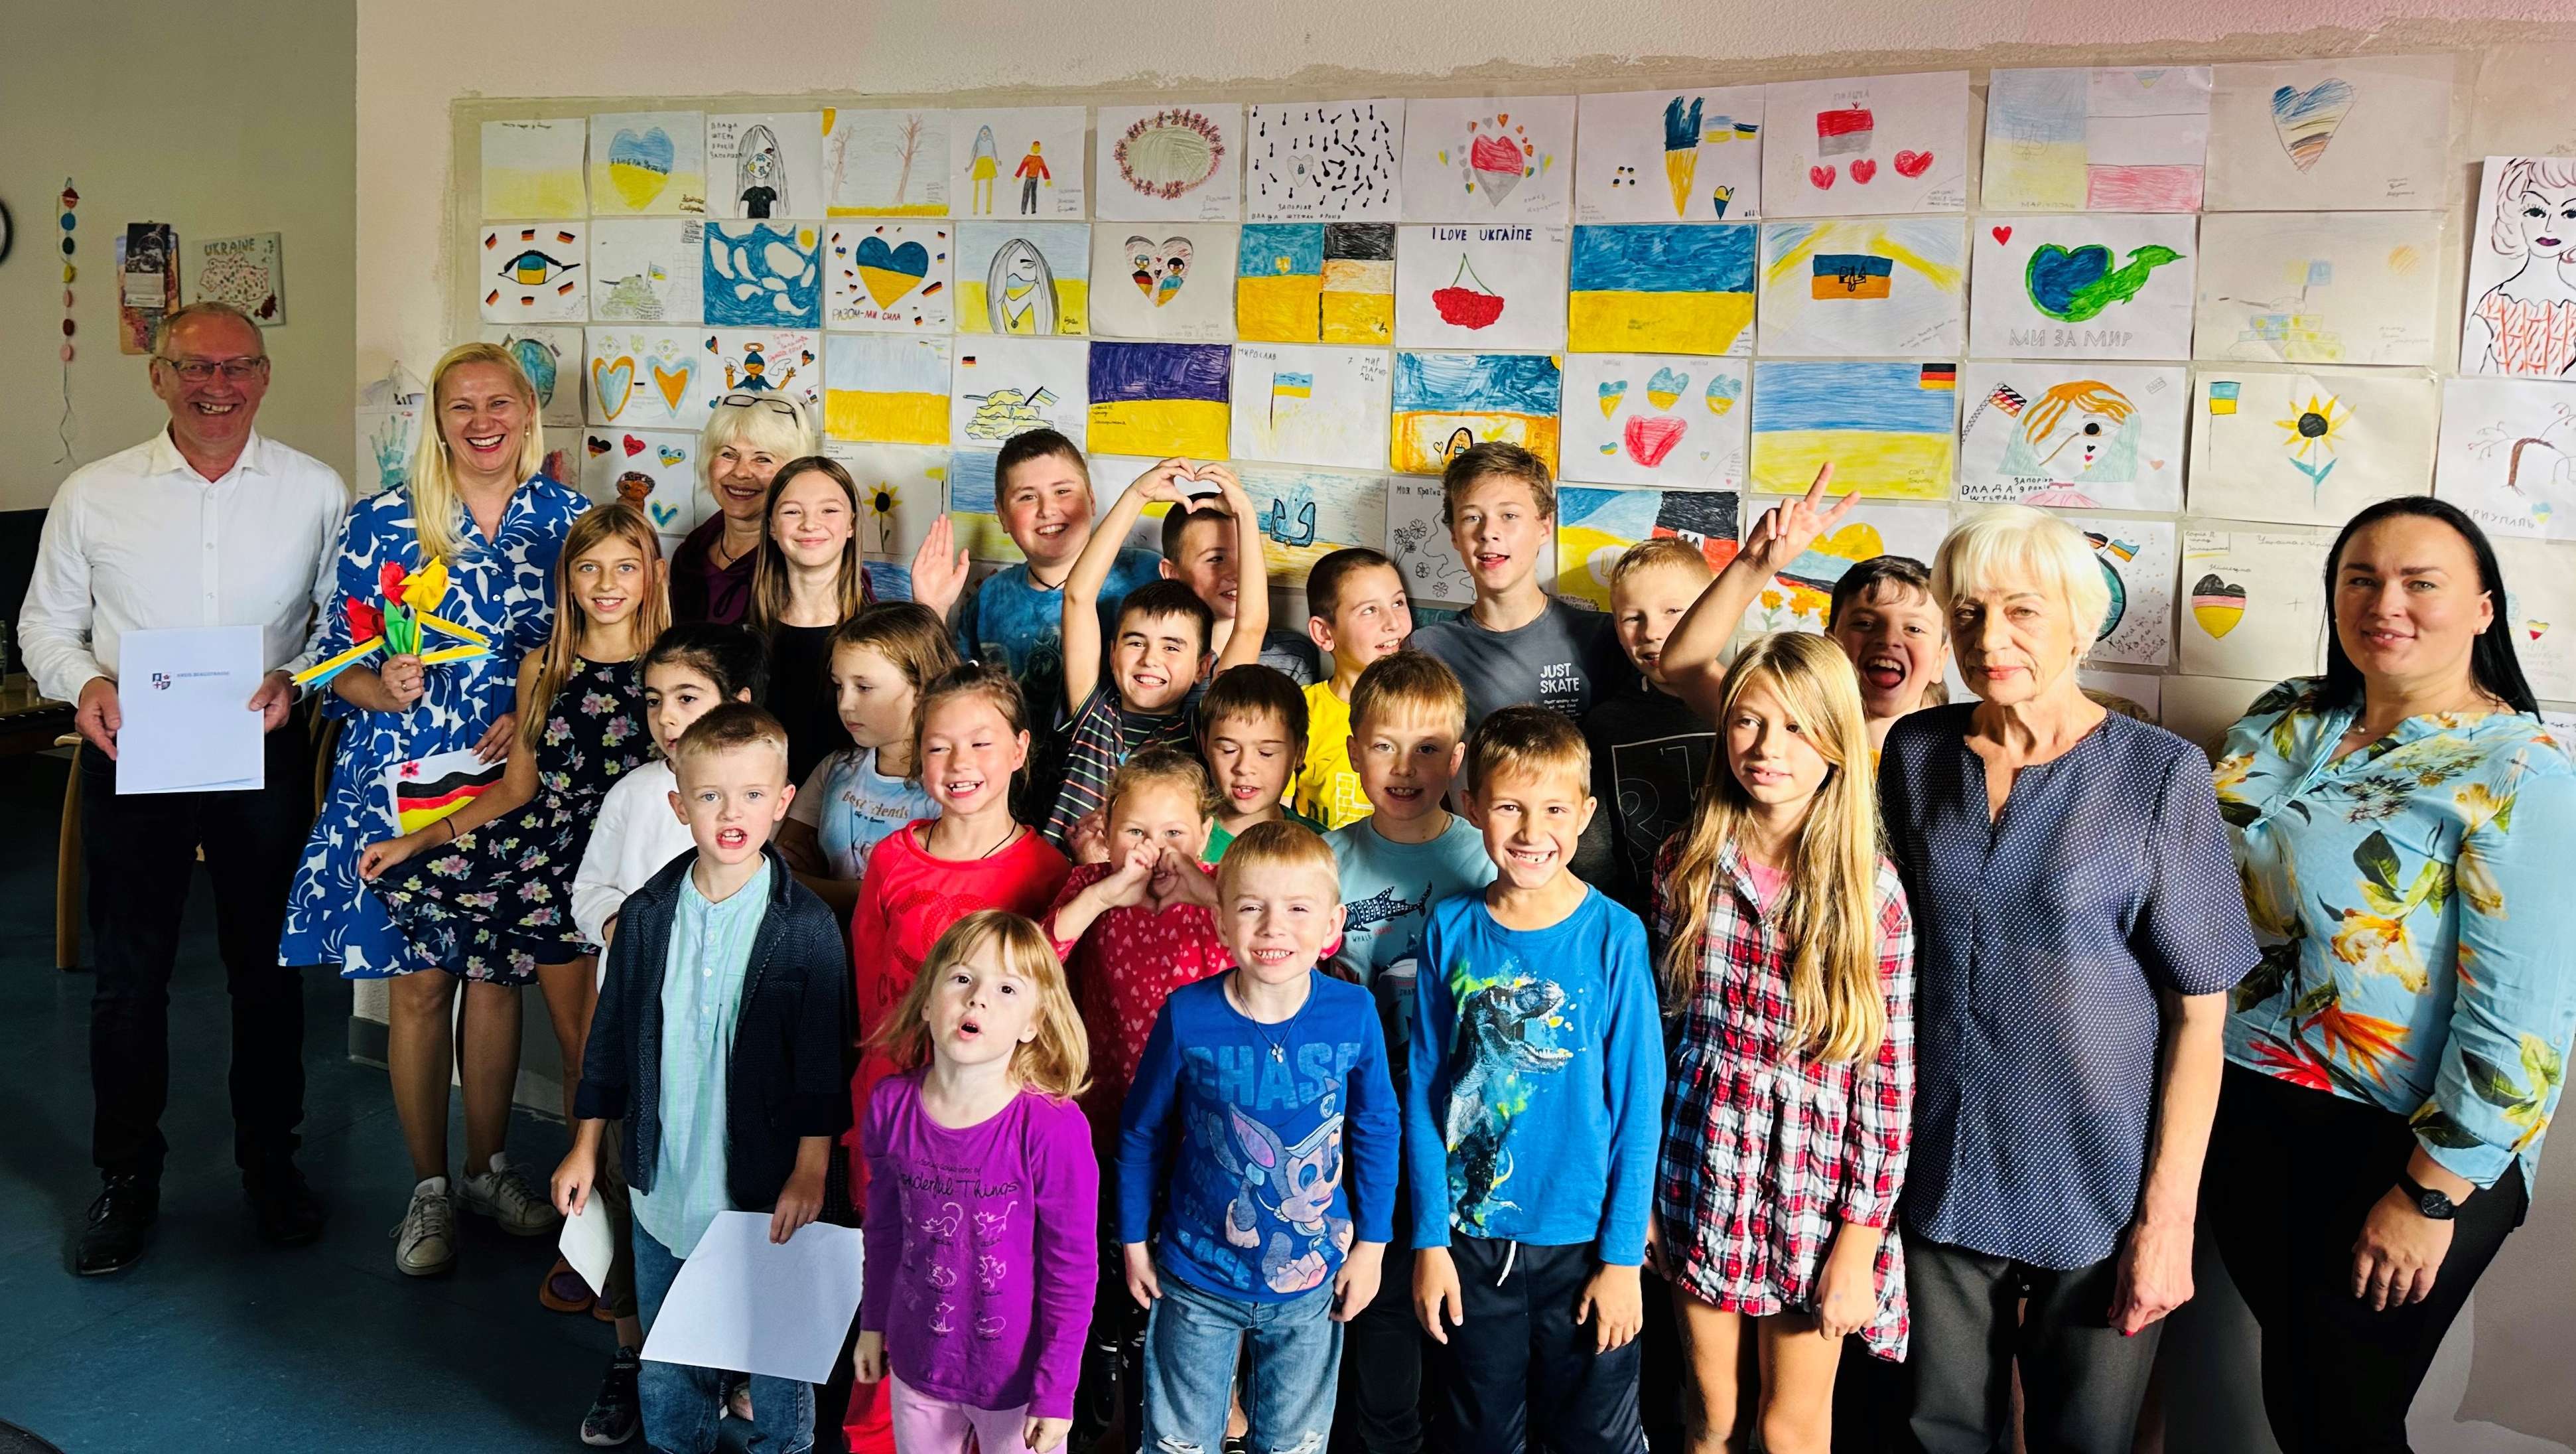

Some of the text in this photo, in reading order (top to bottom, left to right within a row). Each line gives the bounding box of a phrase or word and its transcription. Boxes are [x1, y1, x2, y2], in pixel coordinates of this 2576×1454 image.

[1432, 227, 1436, 240] I
[1440, 228, 1467, 241] LOVE
[204, 238, 255, 256] UKRAINE
[882, 312, 901, 321] СИЛА
[2009, 329, 2134, 347] МИ ЗА МИР
[1237, 348, 1277, 361] МИРОСЛАВ
[1961, 484, 2013, 495] ВЛАДА
[1540, 663, 1571, 678] JUST
[1540, 678, 1580, 693] SKATE
[956, 1179, 1019, 1199] Things
